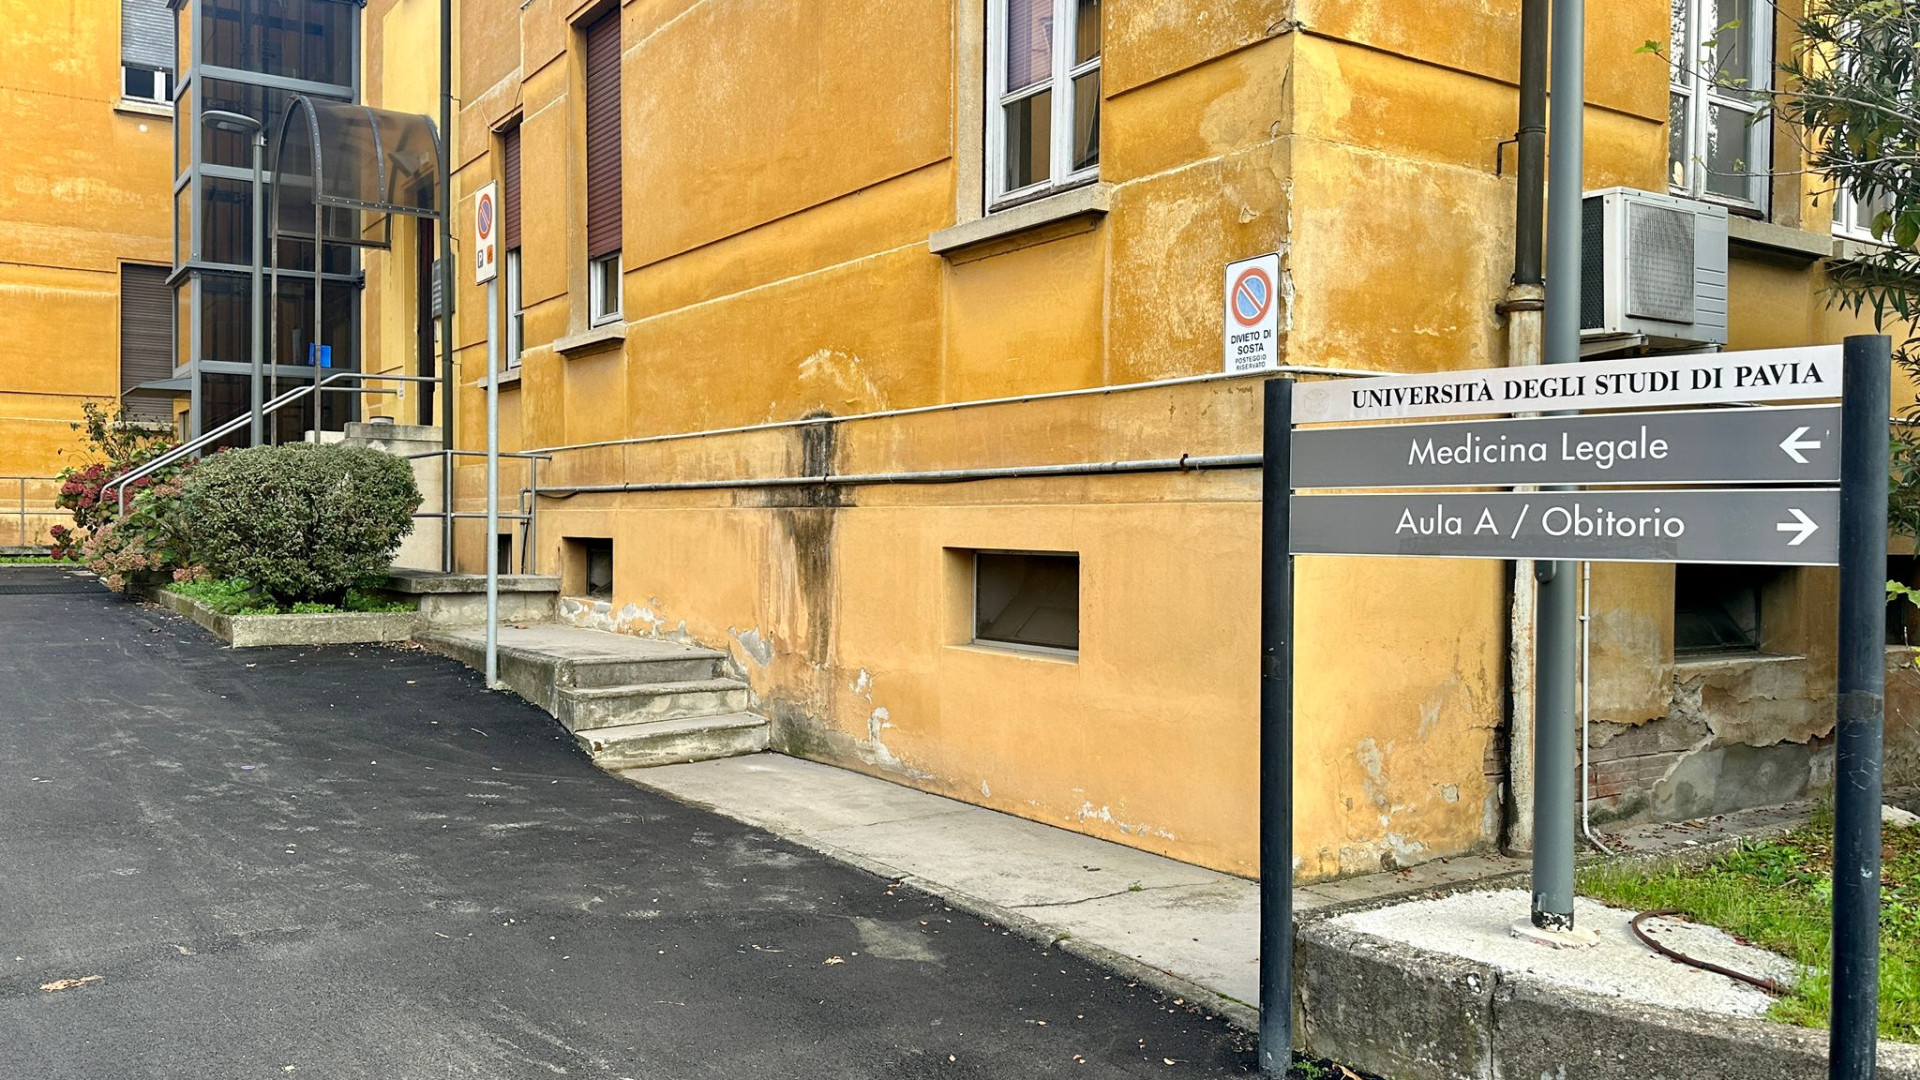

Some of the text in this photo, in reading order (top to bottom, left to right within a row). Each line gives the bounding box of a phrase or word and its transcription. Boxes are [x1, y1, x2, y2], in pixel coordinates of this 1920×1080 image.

[1231, 330, 1271, 344] DIVIETO DI
[1237, 343, 1264, 355] SOSTA
[1235, 354, 1266, 364] POSTEGGIO
[1236, 362, 1266, 370] RISERVATO
[1351, 362, 1824, 409] UNIVERSITÀ DEGLI STUDI DI PAVIA
[1408, 426, 1669, 470] Medicina Legale
[1395, 504, 1685, 540] Aula A / Obitorio
